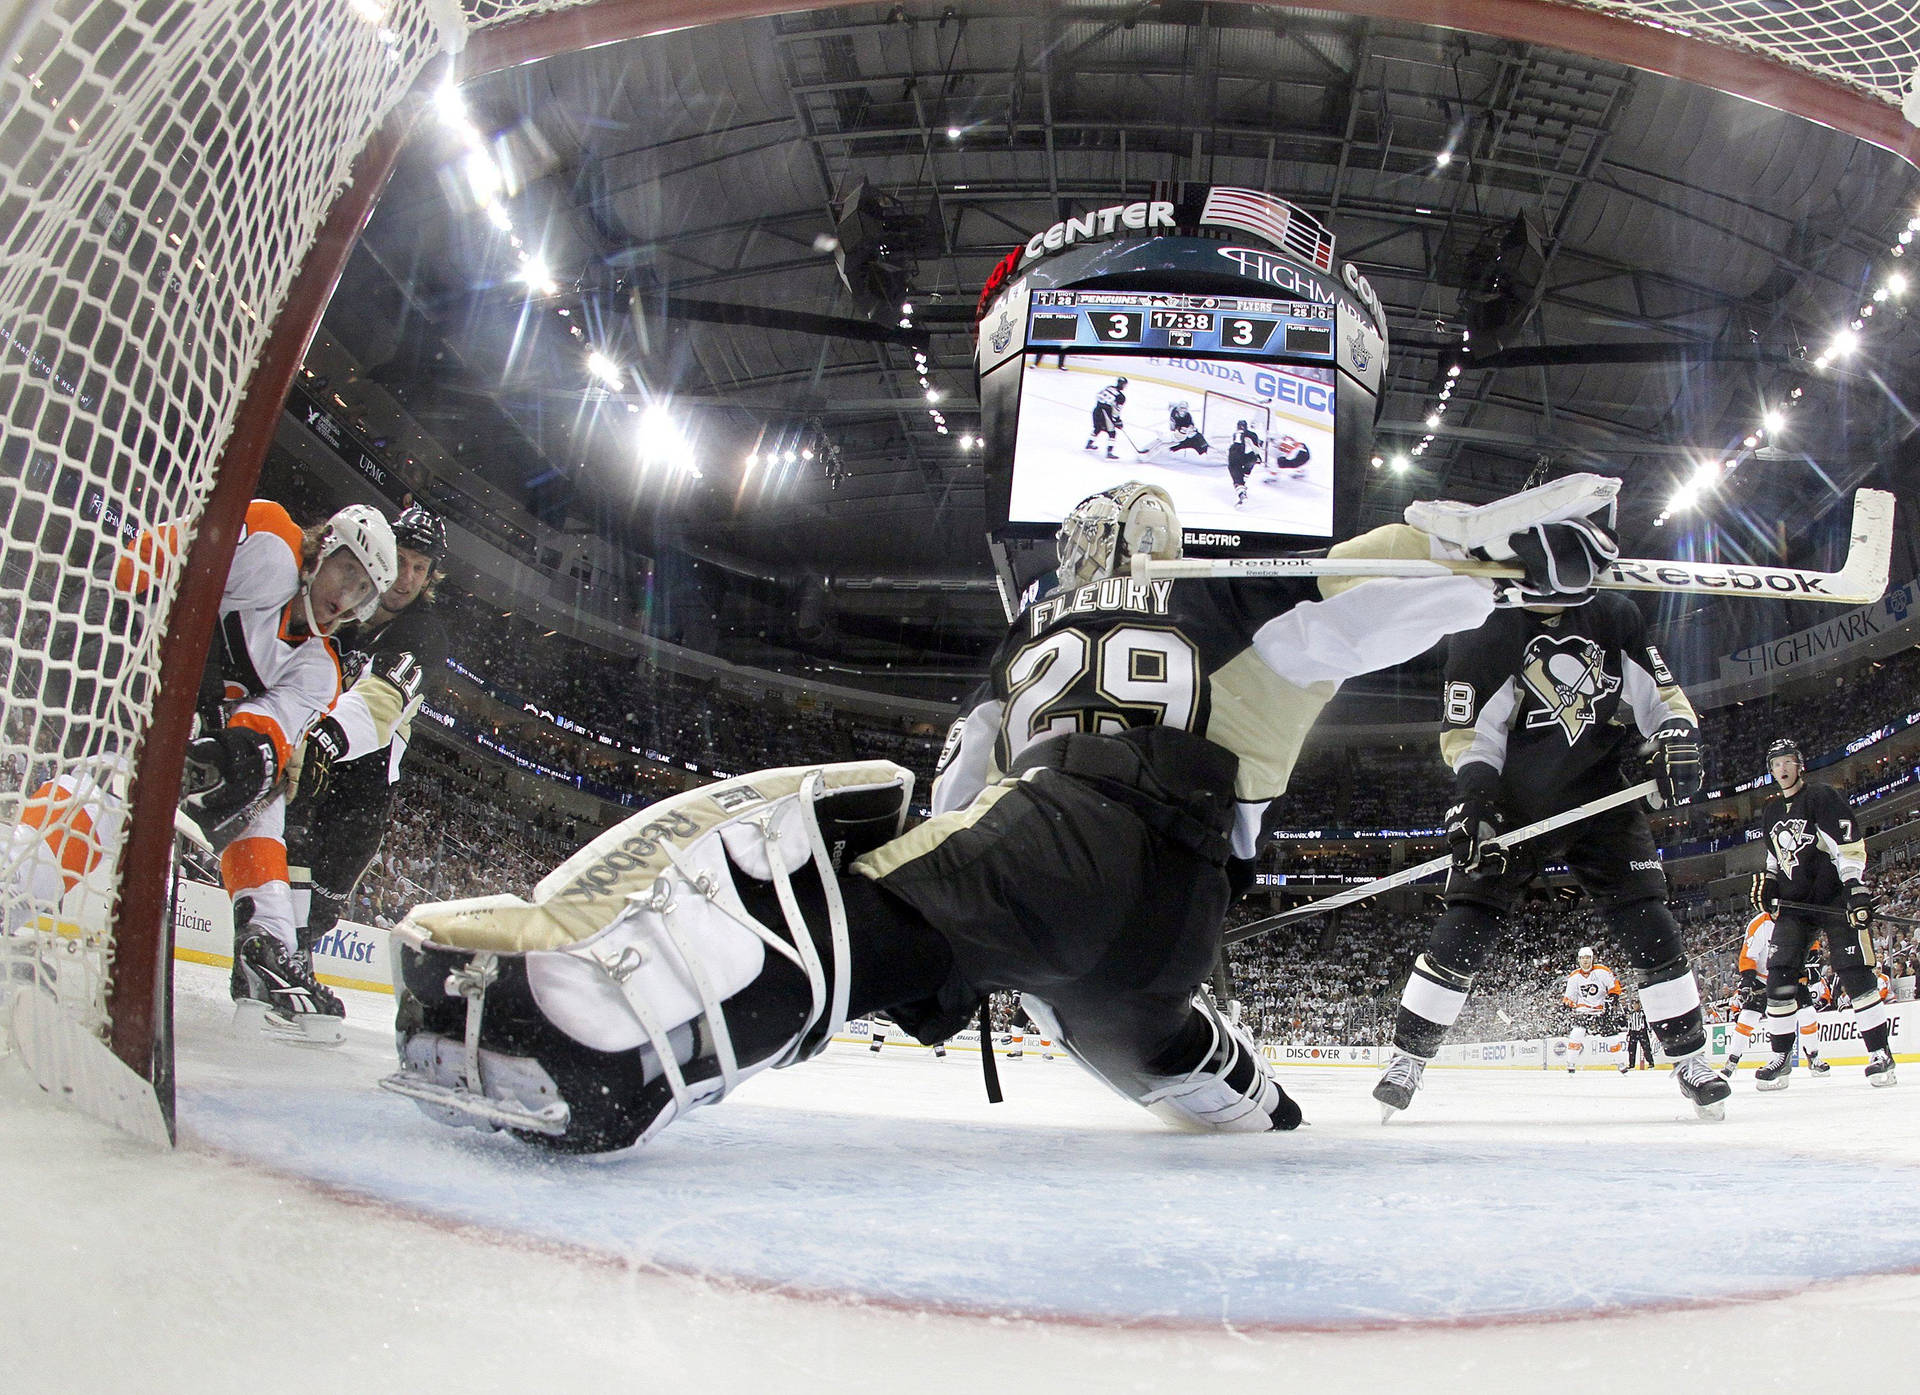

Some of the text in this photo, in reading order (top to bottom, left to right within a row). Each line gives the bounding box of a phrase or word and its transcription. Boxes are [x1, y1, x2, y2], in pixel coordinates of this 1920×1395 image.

[1025, 201, 1176, 259] CENTER
[1057, 296, 1072, 305] 28
[1079, 294, 1138, 305] PENGUINS
[1236, 301, 1272, 312] FLYERS
[1153, 312, 1209, 330] 17:38
[1293, 308, 1308, 318] 25
[1107, 314, 1129, 339] 3
[1232, 320, 1254, 345] 3
[1176, 336, 1184, 346] 4
[42, 363, 59, 382] YOR
[1168, 358, 1245, 384] HONDA
[360, 454, 386, 486] UPMC
[1184, 532, 1241, 546] ELECTRIC
[1229, 559, 1312, 567] Reebok
[1611, 561, 1832, 595] Reebok
[1031, 577, 1175, 638] FLEURY
[1730, 605, 1881, 675] HIGHMARK
[386, 651, 423, 702] 11
[1005, 622, 1199, 772] 29
[658, 754, 671, 764] LAK
[685, 762, 698, 771] VAN
[1707, 790, 1721, 799] VAN
[1838, 819, 1852, 841] 7
[562, 808, 701, 900] Reebok
[1629, 859, 1664, 872] Reebo
[175, 906, 212, 933] dicine
[312, 929, 375, 964] arKist
[1286, 1048, 1340, 1060] DISCOVER
[1482, 1045, 1506, 1060] GEICO
